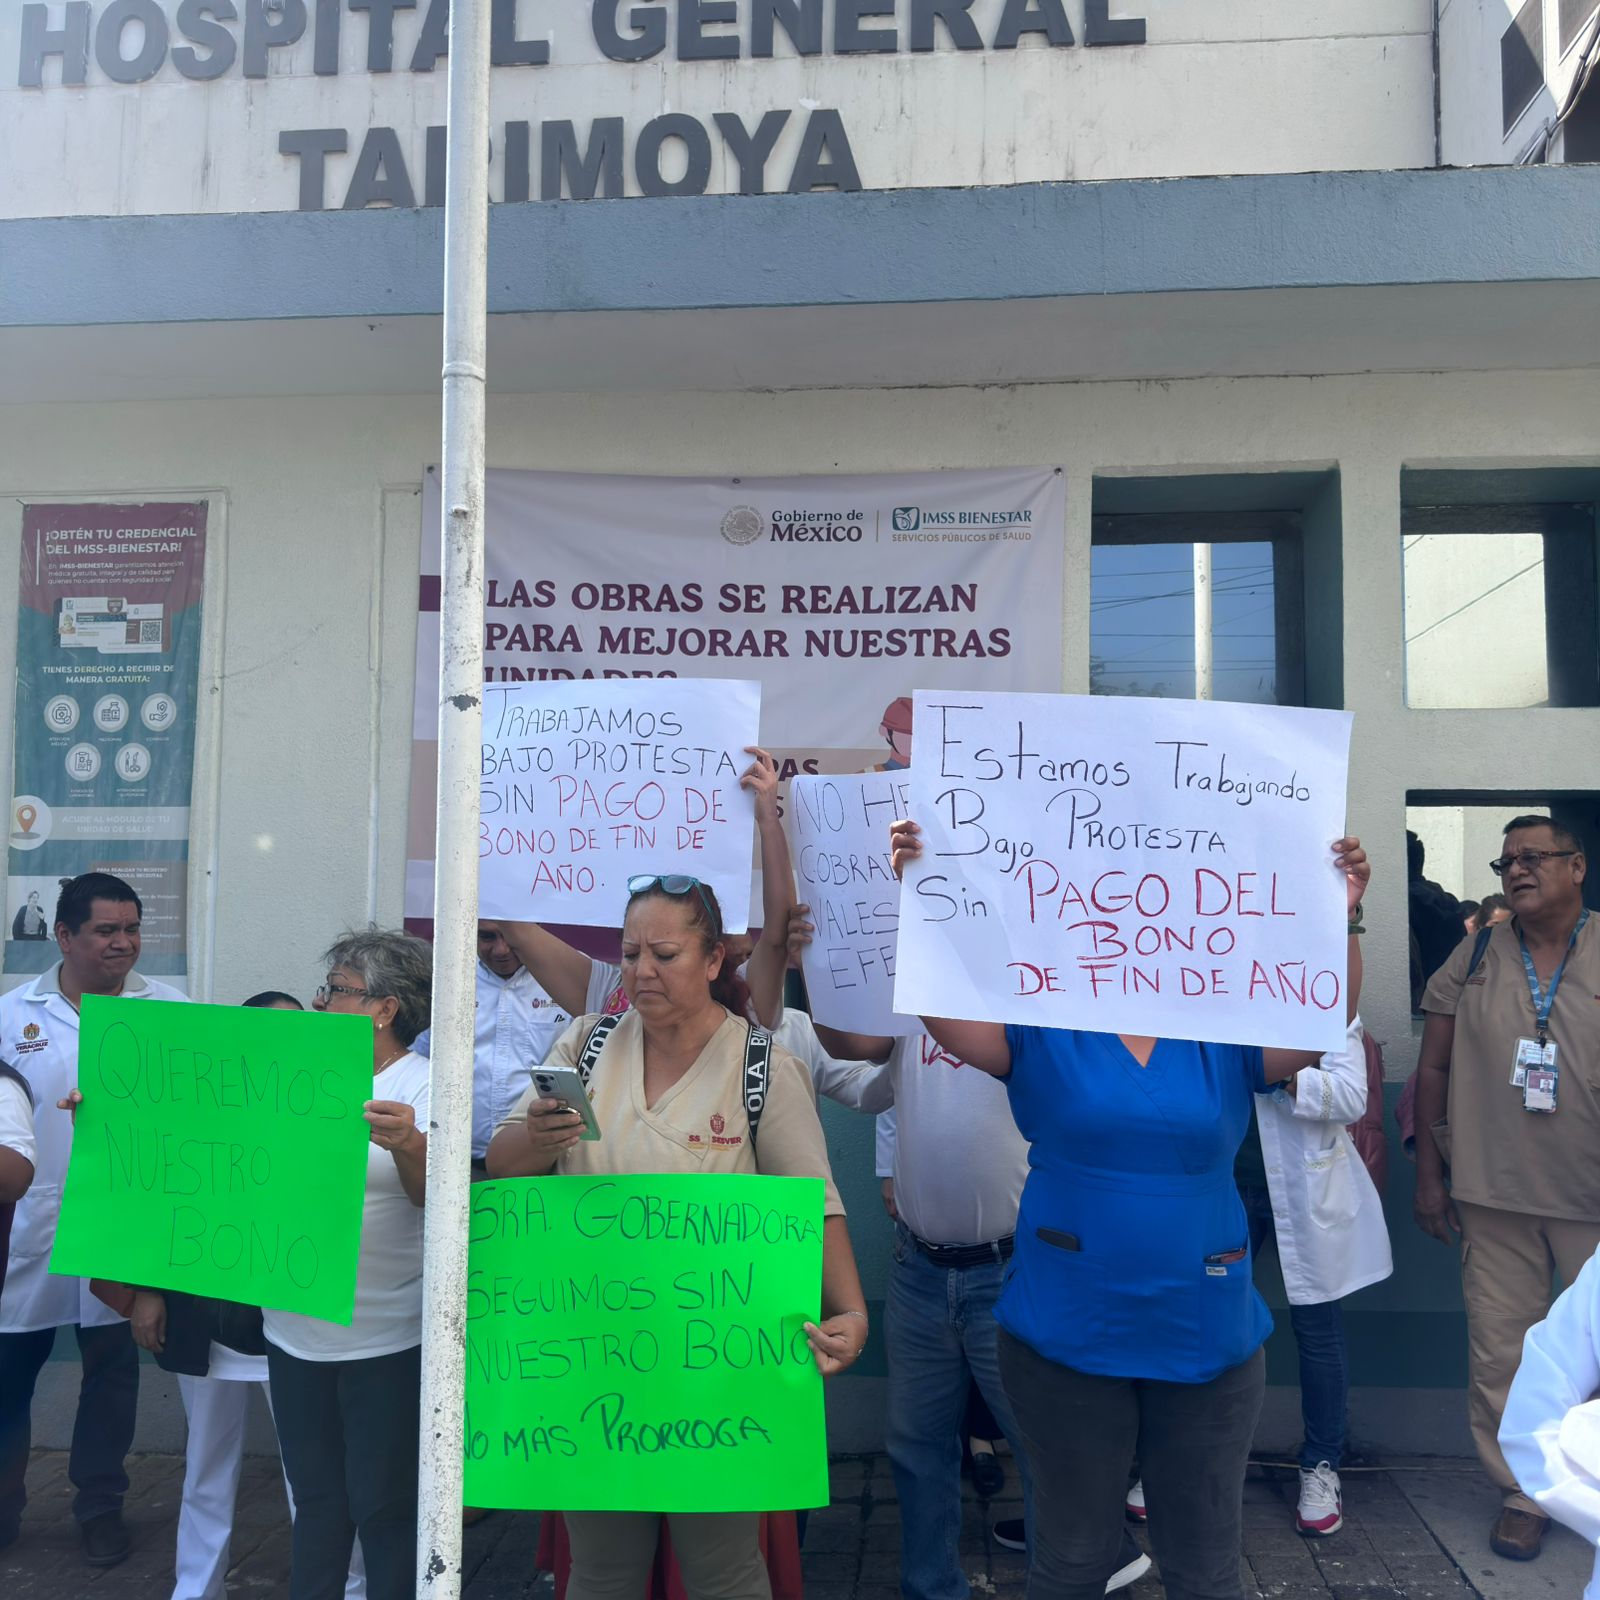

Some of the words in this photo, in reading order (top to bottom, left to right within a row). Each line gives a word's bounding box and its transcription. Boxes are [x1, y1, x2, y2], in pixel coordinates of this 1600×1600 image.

[591, 0, 1147, 63] GENERAL
[45, 528, 93, 541] ¡OBTÉN
[96, 529, 113, 540] TU
[116, 527, 197, 539] CREDENCIAL
[769, 521, 863, 543] México
[771, 509, 842, 523] Gobierno
[846, 510, 863, 521] de
[892, 533, 940, 542] SERVICIOS
[942, 532, 986, 542] PÚBLICOS
[988, 531, 1000, 541] DE
[1002, 531, 1032, 541] SALUD
[922, 511, 955, 525] IMSS
[958, 509, 1032, 524] BIENESTAR
[46, 544, 70, 555] DEL
[73, 542, 182, 554] IMSS-BIENESTAR!
[486, 579, 556, 608] LAS
[571, 583, 703, 613] OBRAS
[718, 583, 766, 613] SE
[781, 583, 978, 614] REALIZAN
[485, 623, 583, 652] PARA
[598, 626, 790, 657] MEJORAR
[804, 628, 1011, 658] NUESTRAS
[66, 675, 104, 684] MANERA
[74, 665, 116, 673] DERECHO
[118, 665, 125, 673] A
[126, 665, 161, 673] RECIBIR
[486, 687, 683, 739] TRABAJAMOS
[481, 743, 553, 775] BAJO
[568, 738, 737, 777] PROTESTA
[1154, 741, 1311, 806] Trabajando
[480, 781, 534, 814] SIN
[549, 774, 666, 820] PAGO
[685, 786, 728, 823] DE
[795, 782, 845, 833] NO
[479, 822, 555, 857] BONO
[570, 827, 601, 853] DE
[608, 824, 657, 850] FIN
[677, 825, 705, 850] DE
[934, 788, 1034, 873] Bajo
[531, 860, 605, 895] AÑO.
[915, 875, 987, 922] Sin
[1014, 859, 1170, 923] PAGO
[1195, 868, 1295, 916] DEL
[1066, 921, 1236, 960] BONO
[1007, 962, 1066, 996] DE
[1078, 964, 1161, 999] FIN
[1180, 967, 1229, 995] DE
[1248, 960, 1340, 1010] AÑO
[98, 1021, 348, 1120] QUEREMOS
[104, 1122, 271, 1196] NUESTRO
[469, 1187, 552, 1243] SRA.
[573, 1182, 822, 1245] GOBERNADORA
[168, 1206, 319, 1289] BONO
[466, 1270, 656, 1320] SEGUIMOS
[673, 1262, 754, 1309] SIN
[468, 1330, 658, 1384] NUESTRO
[682, 1316, 811, 1369] BONO
[503, 1415, 578, 1463] MÁS
